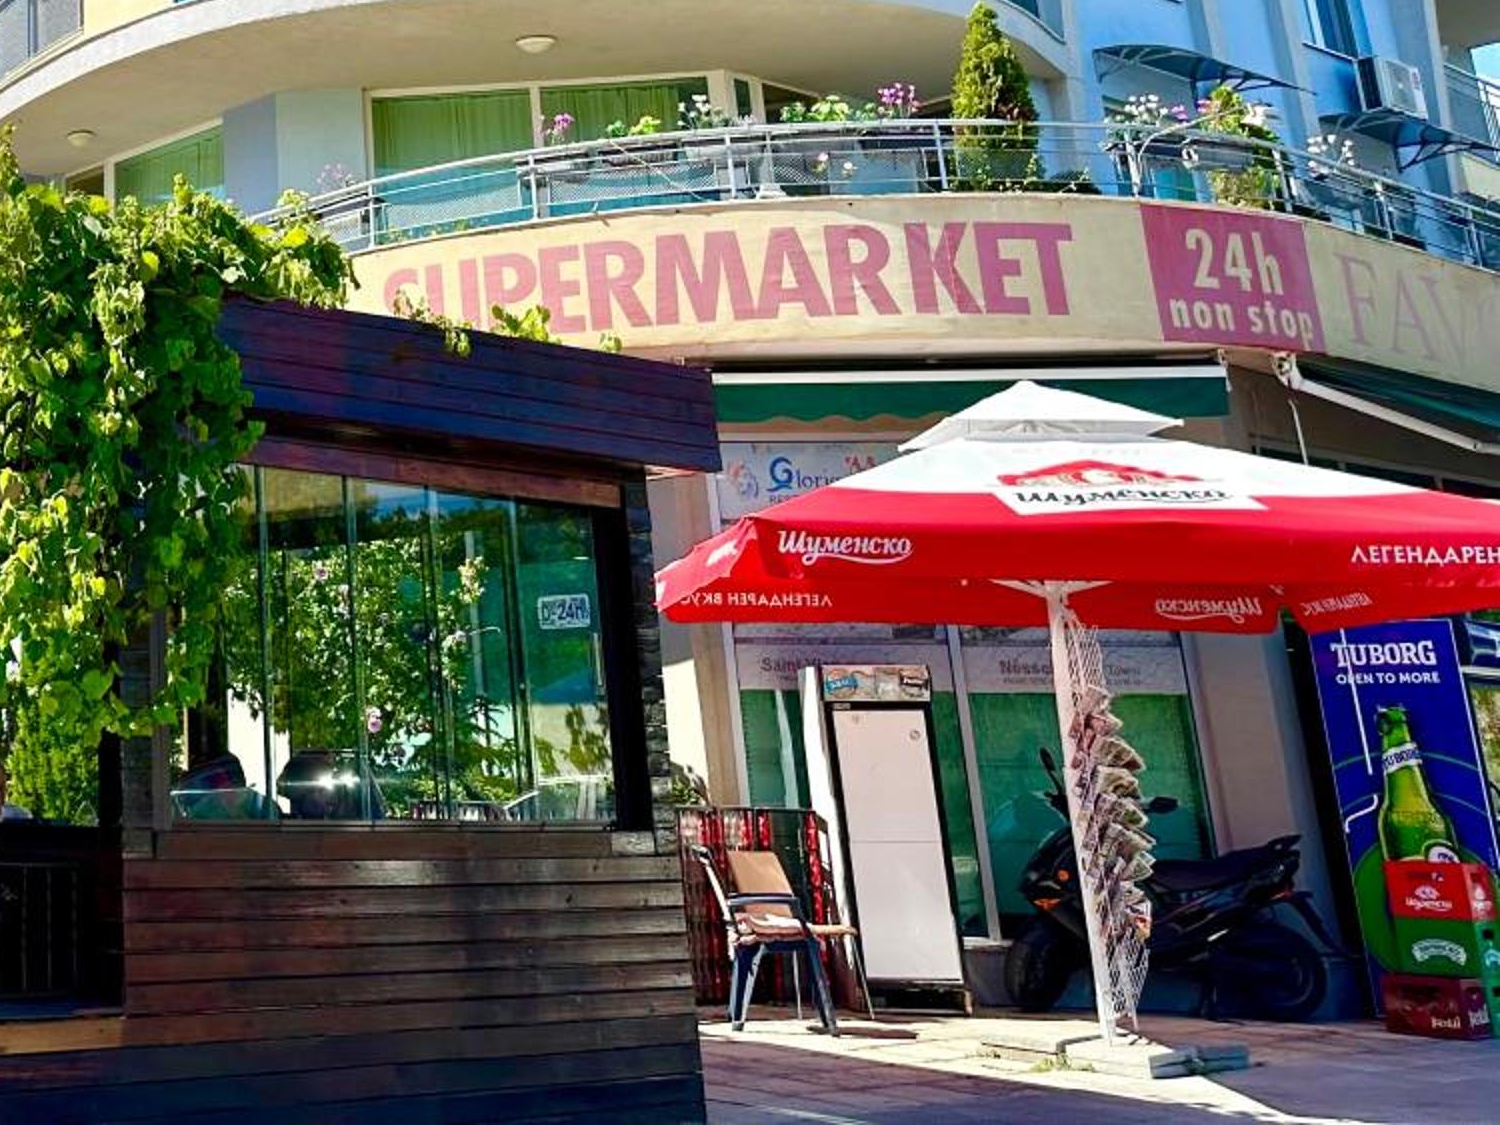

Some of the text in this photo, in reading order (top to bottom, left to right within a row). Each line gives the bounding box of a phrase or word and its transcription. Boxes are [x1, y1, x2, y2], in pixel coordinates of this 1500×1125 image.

[384, 222, 1072, 334] SUPERMARKET
[1185, 227, 1285, 296] 24h
[1169, 297, 1315, 351] non stop
[777, 530, 914, 566] Шуменско
[1350, 544, 1500, 567] ЛЕГЕНДАРЕН
[1329, 640, 1438, 668] TUBORG
[1376, 673, 1396, 684] TO
[1400, 671, 1441, 684] MORE
